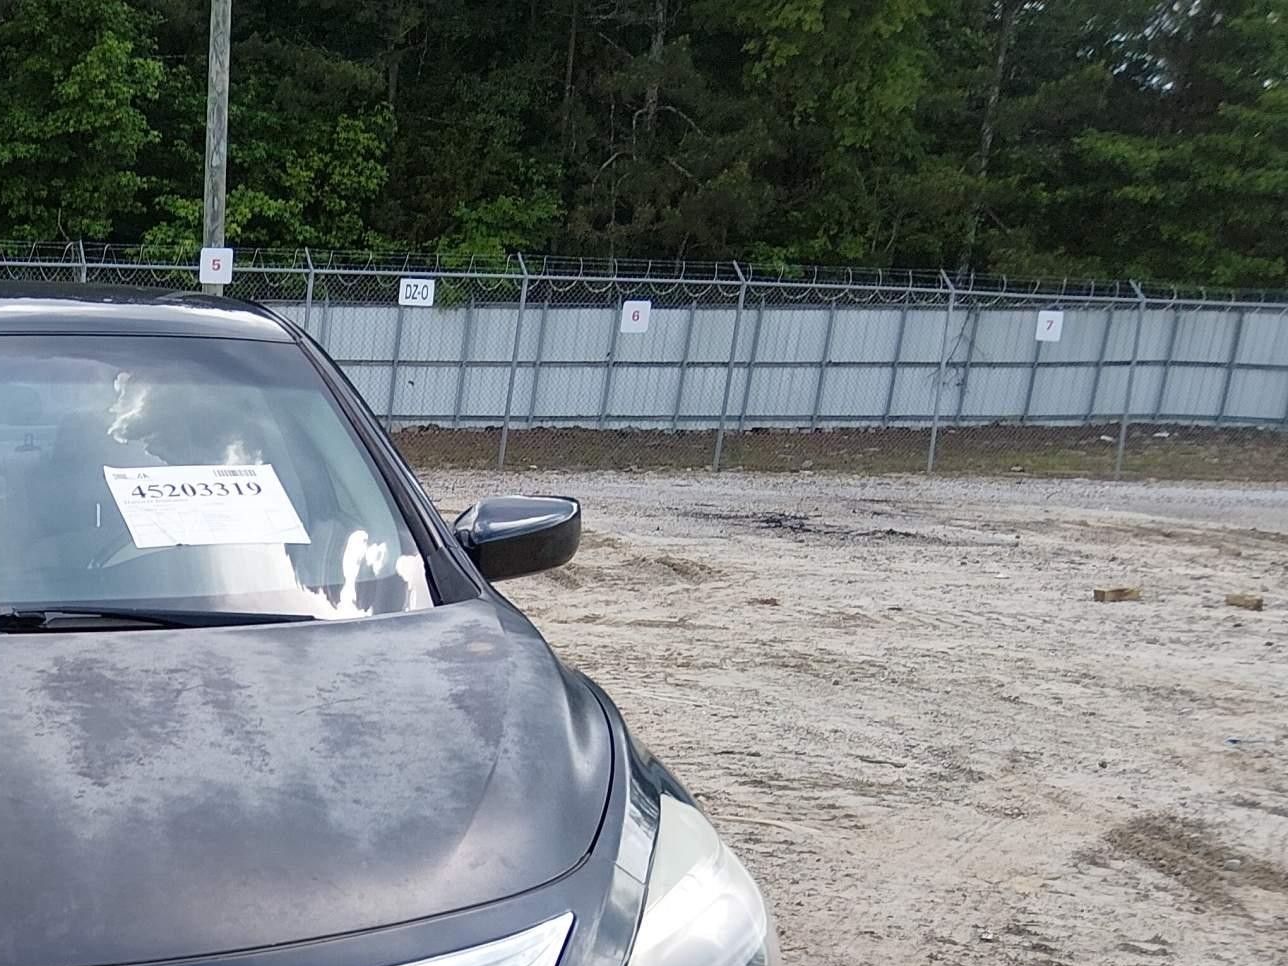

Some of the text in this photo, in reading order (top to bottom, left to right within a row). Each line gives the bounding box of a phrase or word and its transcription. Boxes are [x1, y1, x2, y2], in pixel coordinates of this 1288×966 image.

[212, 259, 221, 271] 5
[632, 310, 640, 322] 6
[1046, 319, 1054, 331] 7
[131, 481, 262, 499] 45203319
